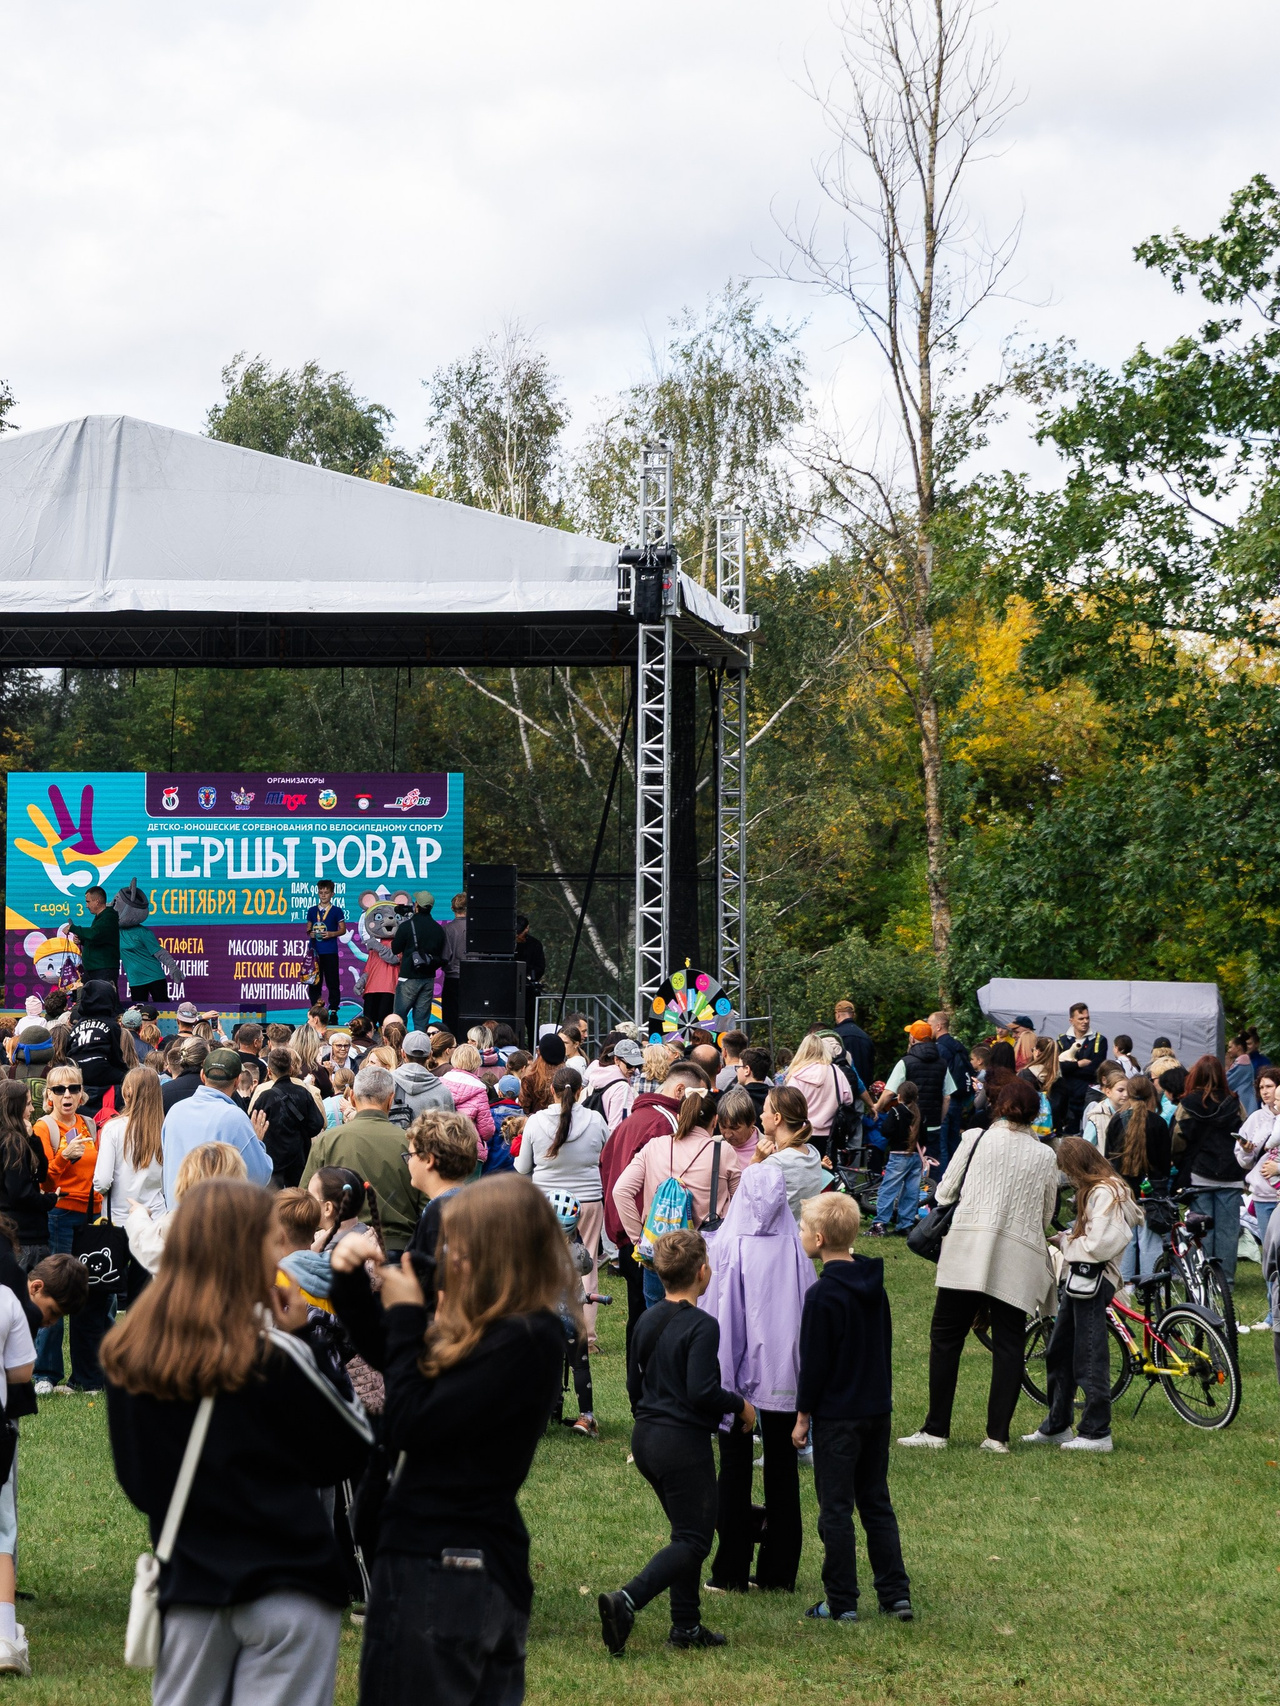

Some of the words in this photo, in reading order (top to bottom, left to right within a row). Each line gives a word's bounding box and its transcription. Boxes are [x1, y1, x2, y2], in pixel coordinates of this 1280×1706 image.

[147, 823, 240, 831] ДЕТСКО-ЮНОШЕСКИЕ
[242, 823, 313, 831] СОРЕВНОВАНИЯ
[329, 824, 408, 832] ВЕЛОСИПЕДНОМУ
[409, 824, 444, 832] СПОРТУ
[146, 836, 300, 879] ПЕРШЫ
[312, 834, 443, 879] РОВАР
[291, 882, 310, 894] ПАРК
[161, 889, 236, 915] СЕНТЯБРЯ
[241, 888, 287, 915] 2026
[291, 896, 317, 909] ГОРОДА
[228, 939, 278, 956] МАССОВЫЕ
[282, 940, 310, 957] ЗАЕЗД
[233, 962, 275, 980] ДЕТСКИЕ
[278, 962, 303, 979] СТАР
[240, 982, 310, 1000] МАУНТИНБАЙК
[70, 1020, 111, 1038] MEMORIES
[78, 1029, 94, 1046] M
